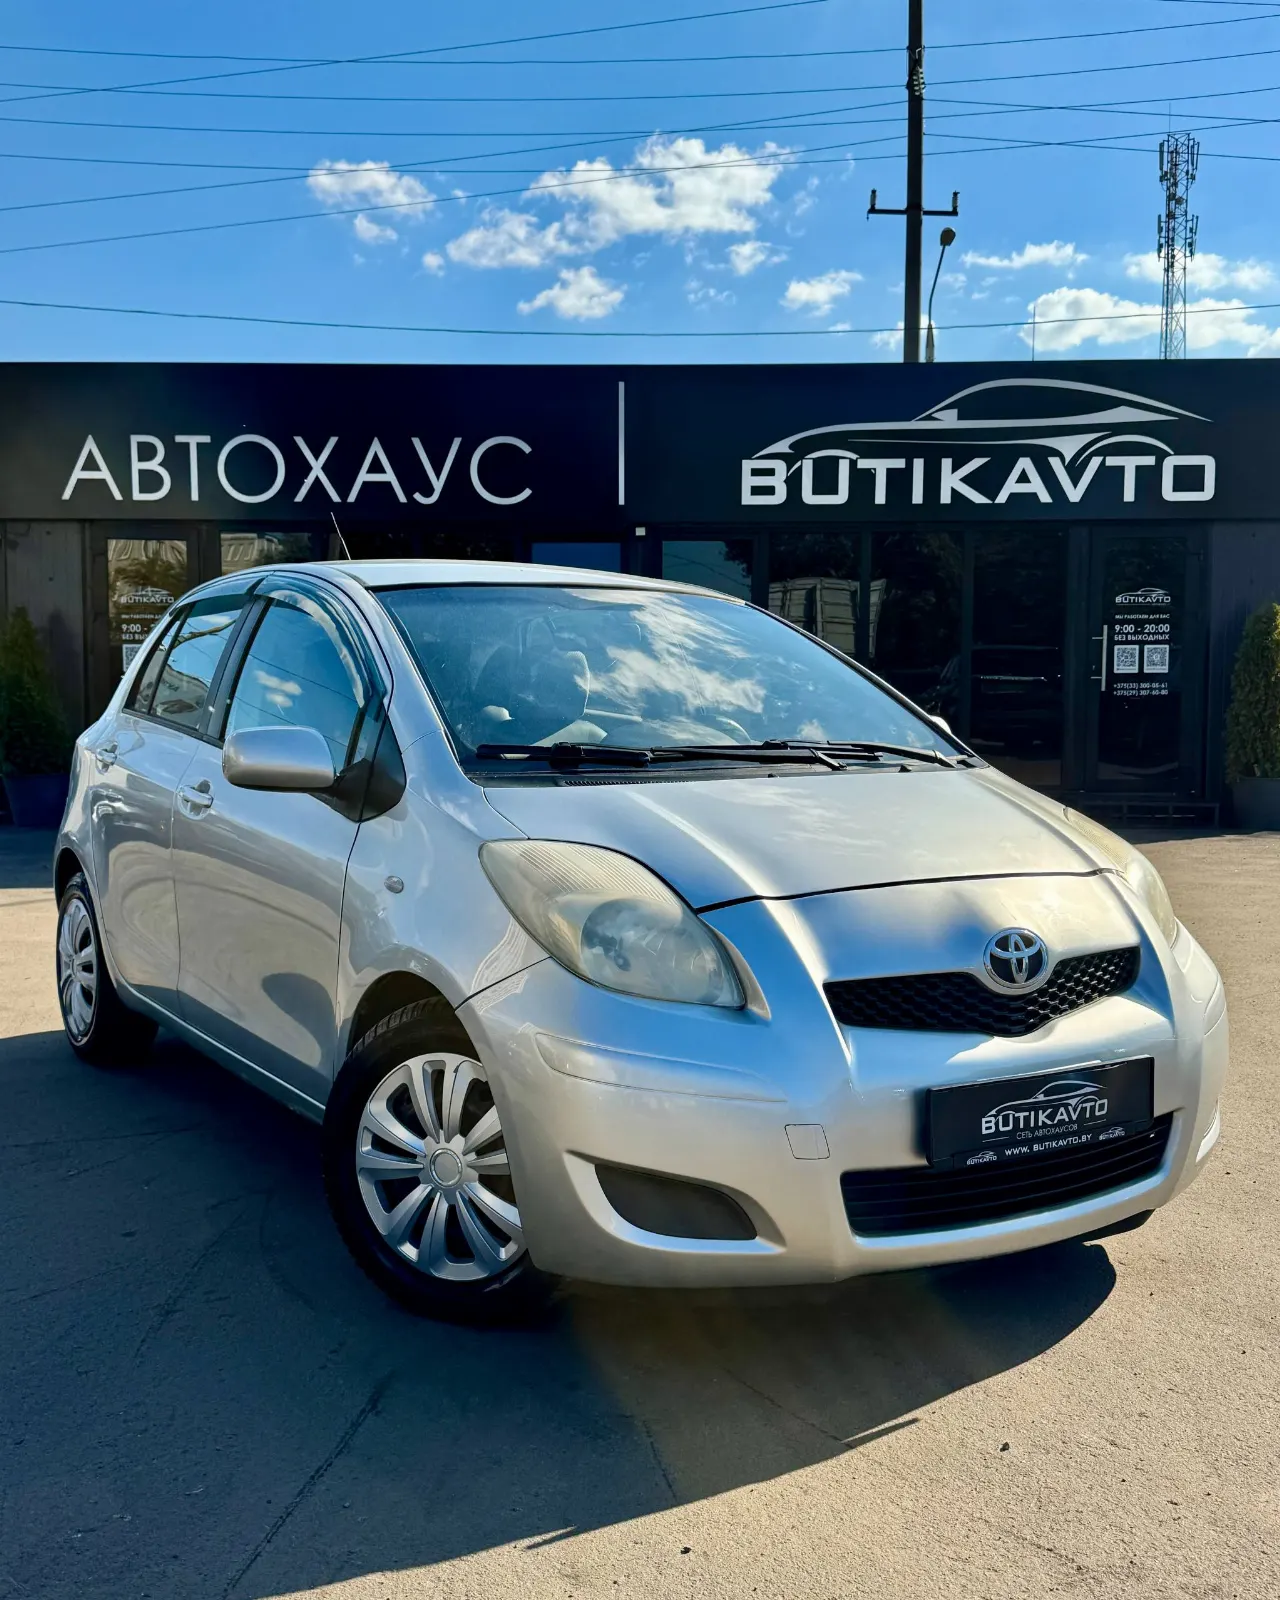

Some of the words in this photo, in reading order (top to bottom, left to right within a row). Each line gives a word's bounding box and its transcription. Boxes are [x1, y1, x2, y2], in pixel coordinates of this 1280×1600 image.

[61, 434, 533, 505] АВТОХАУС
[741, 453, 1216, 506] BUTIKAVTO
[1115, 595, 1171, 603] BUTIKAVTO
[121, 624, 142, 632] 9:00
[1114, 624, 1135, 633] 9:00
[1143, 624, 1170, 633] 20:00
[981, 1098, 1108, 1135] BUTIKAVTO
[1016, 1130, 1033, 1140] СЕТЬ
[1034, 1123, 1078, 1138] АВТОХАУСОВ
[1004, 1146, 1030, 1156] WWW.
[1033, 1133, 1093, 1152] BUTIKAVTO.BY
[966, 1155, 998, 1165] BUTIKAVTO
